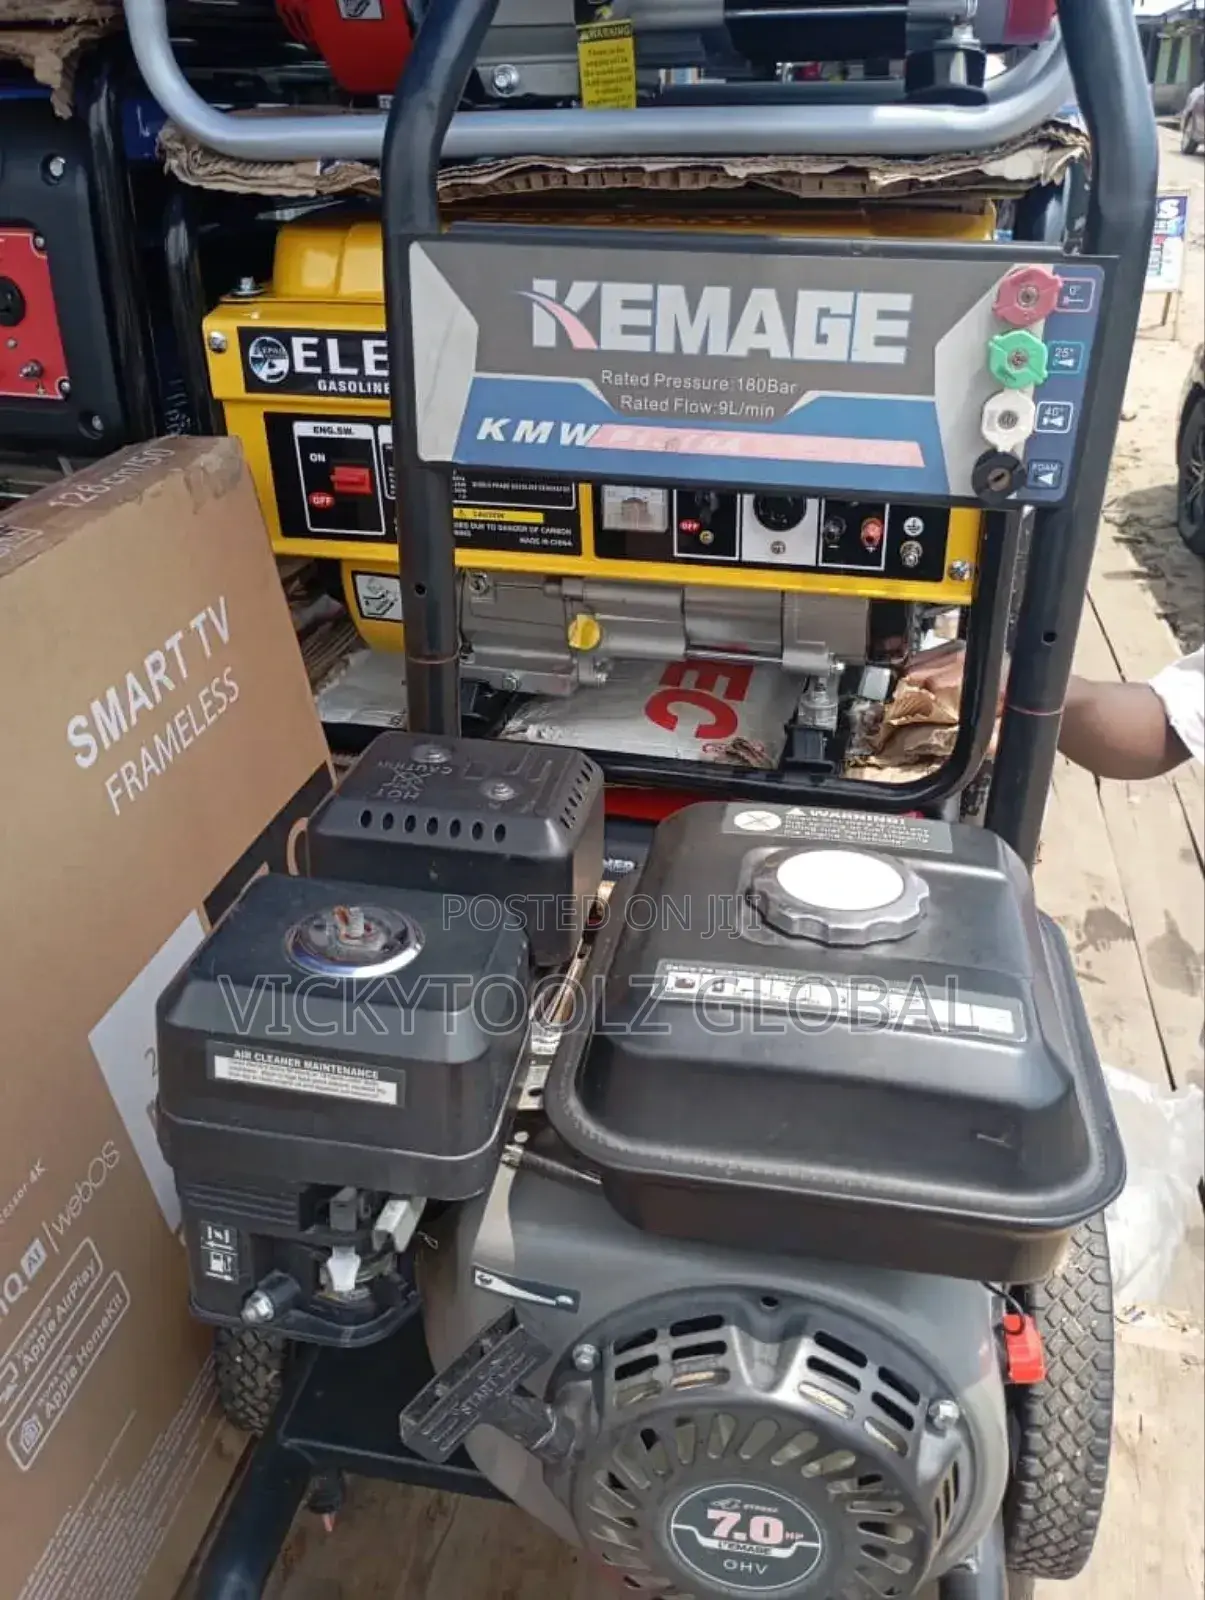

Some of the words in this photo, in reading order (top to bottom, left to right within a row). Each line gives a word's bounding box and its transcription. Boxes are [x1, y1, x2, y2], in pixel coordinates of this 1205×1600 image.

[510, 277, 913, 364] KEMAGE
[291, 336, 389, 378] ELE
[601, 370, 650, 387] Rated
[620, 395, 669, 412] Rated
[309, 453, 326, 463] ON
[312, 496, 332, 506] OFF
[679, 522, 700, 532] OFF
[66, 629, 189, 769] SMART
[189, 595, 230, 659] TV
[104, 665, 240, 816] FRAMELESS
[233, 1050, 252, 1060] AIR
[254, 1052, 301, 1068] CLEANER
[303, 1059, 379, 1080] MAINTENANCE
[51, 1139, 121, 1236] webOS
[20, 1318, 56, 1373] Apple
[54, 1257, 97, 1323] AirPlay
[43, 1365, 79, 1419] Apple
[75, 1292, 124, 1366] HomeKit
[706, 1508, 784, 1545] 7.0
[722, 1558, 770, 1575] OHV
